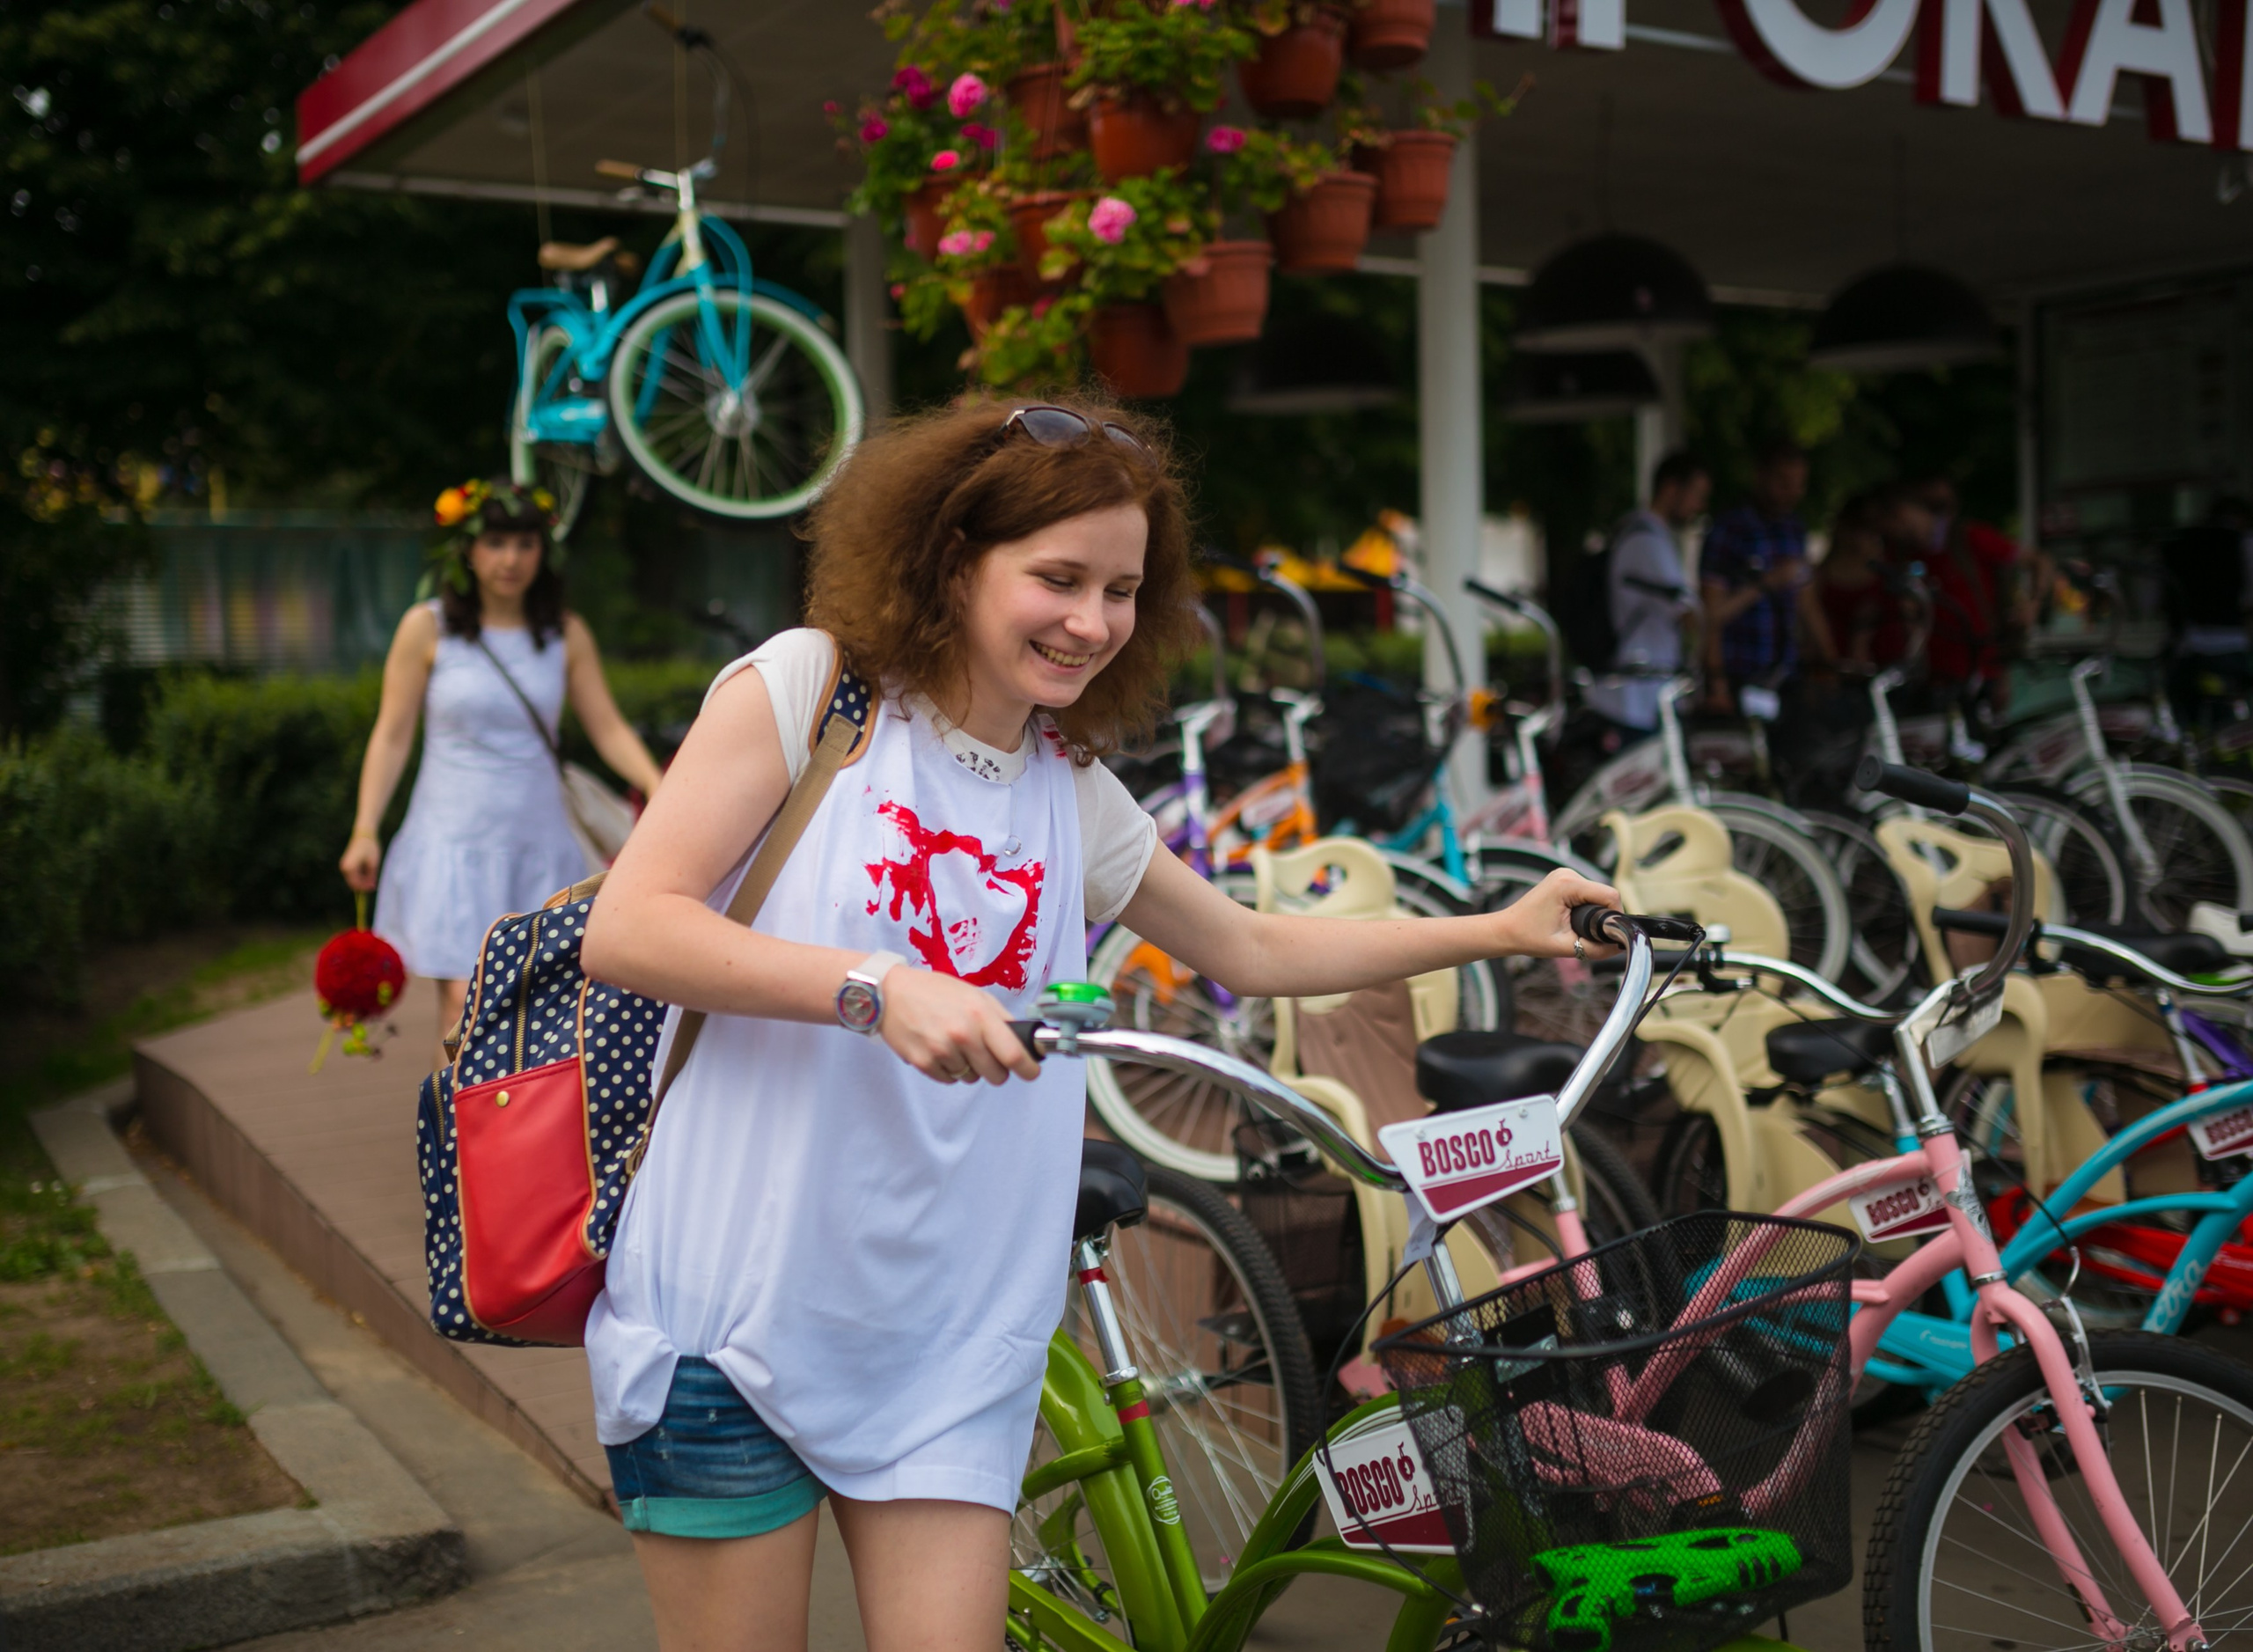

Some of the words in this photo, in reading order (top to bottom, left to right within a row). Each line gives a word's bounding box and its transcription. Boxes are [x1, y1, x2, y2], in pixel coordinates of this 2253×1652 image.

[1418, 1128, 1495, 1178] BOSCO
[1503, 1141, 1560, 1170] Sport
[1866, 1187, 1919, 1226] BOSCO
[1334, 1457, 1405, 1519] BOSCO
